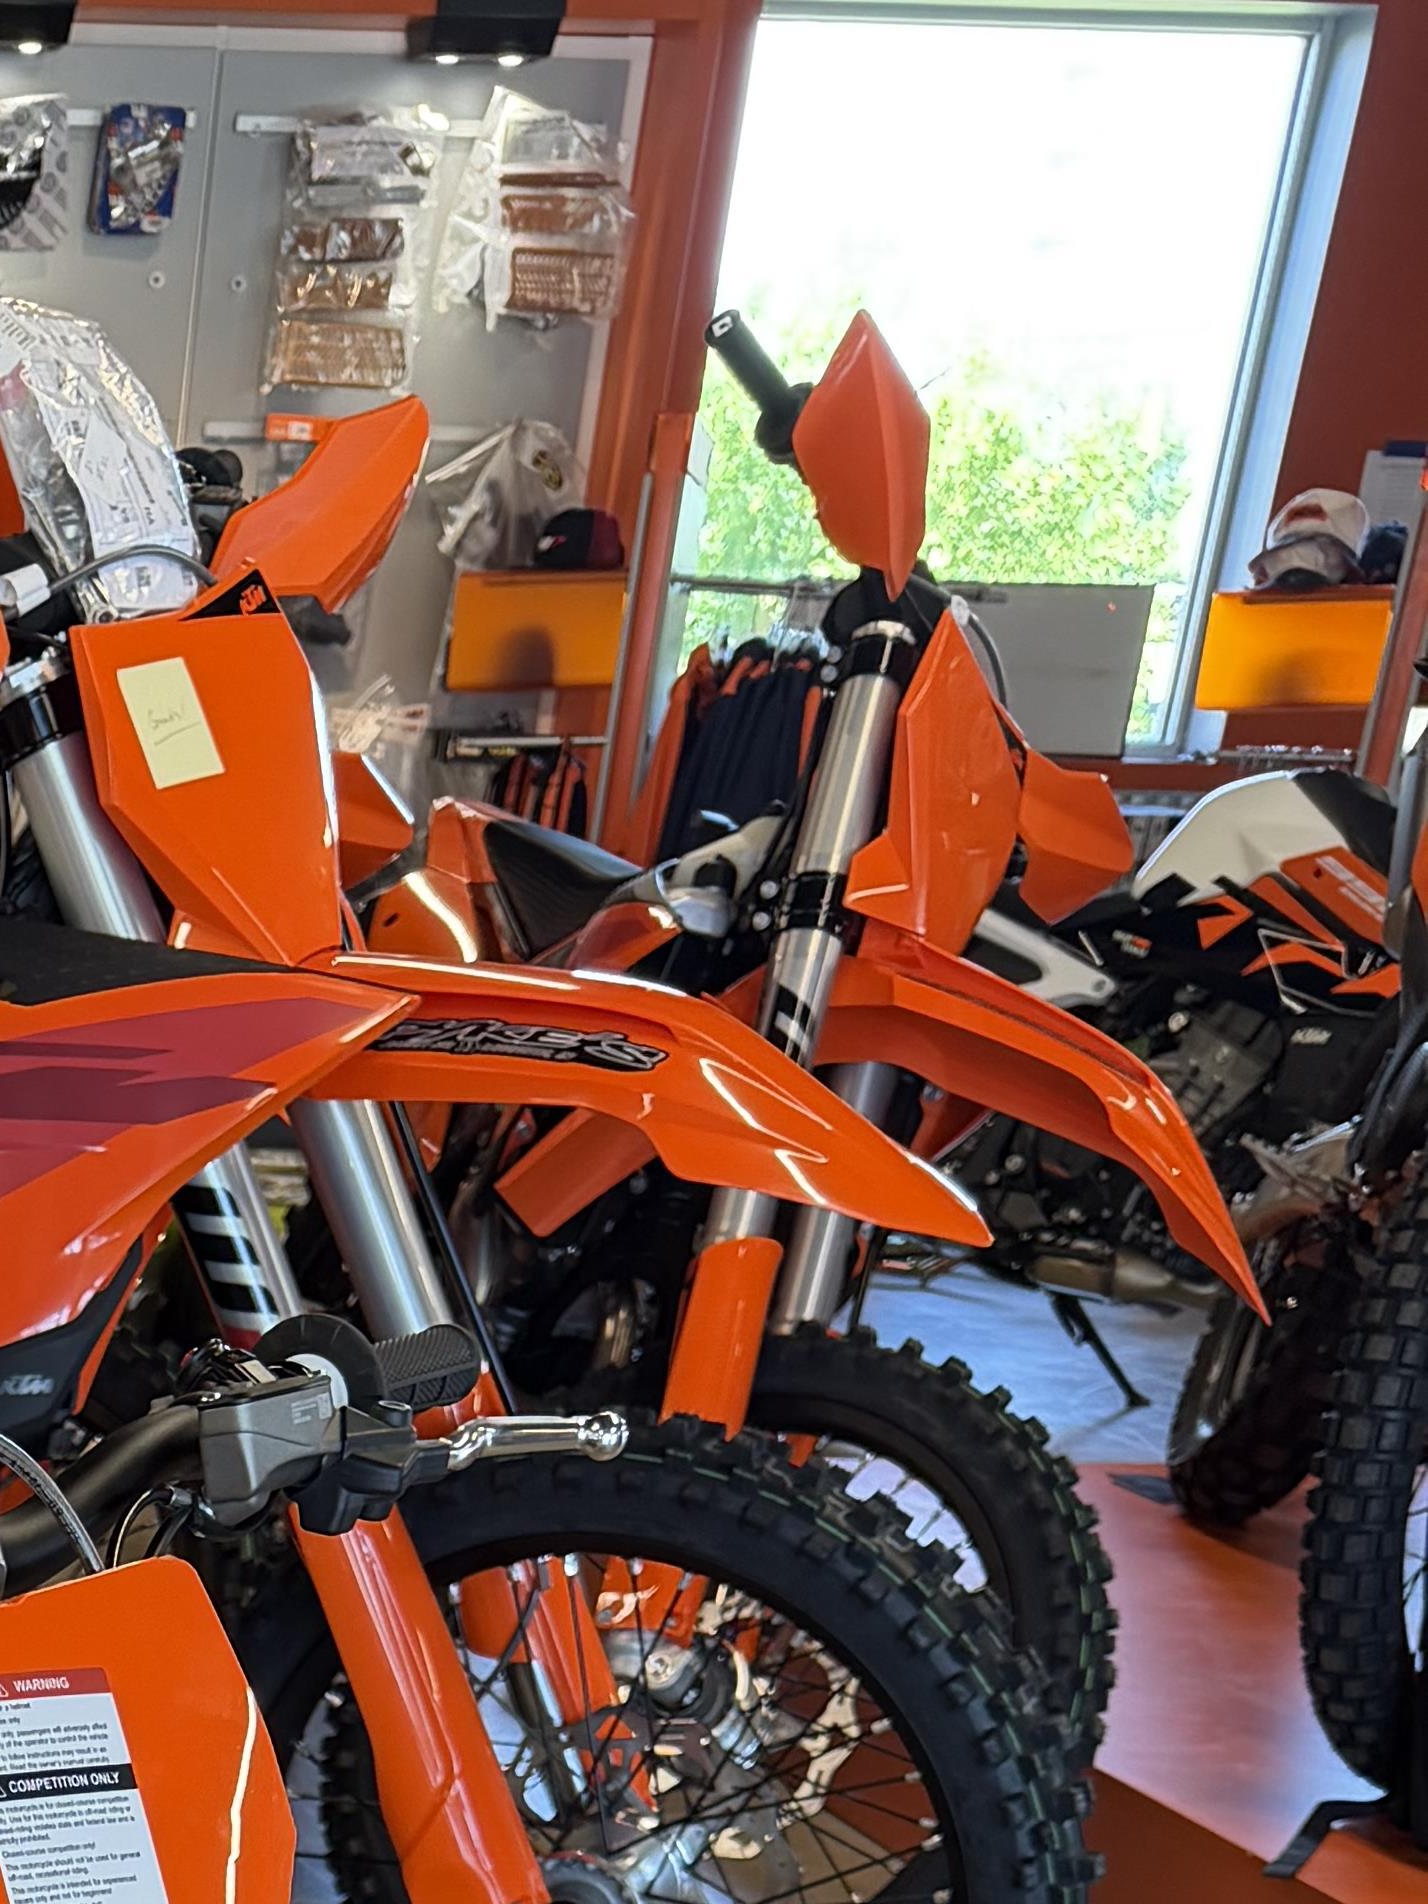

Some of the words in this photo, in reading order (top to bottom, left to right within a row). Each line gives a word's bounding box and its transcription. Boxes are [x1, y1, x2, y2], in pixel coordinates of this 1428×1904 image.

[12, 1675, 70, 1692] WARNING
[8, 1772, 88, 1793] COMPETITION
[88, 1769, 122, 1786] ONLY
